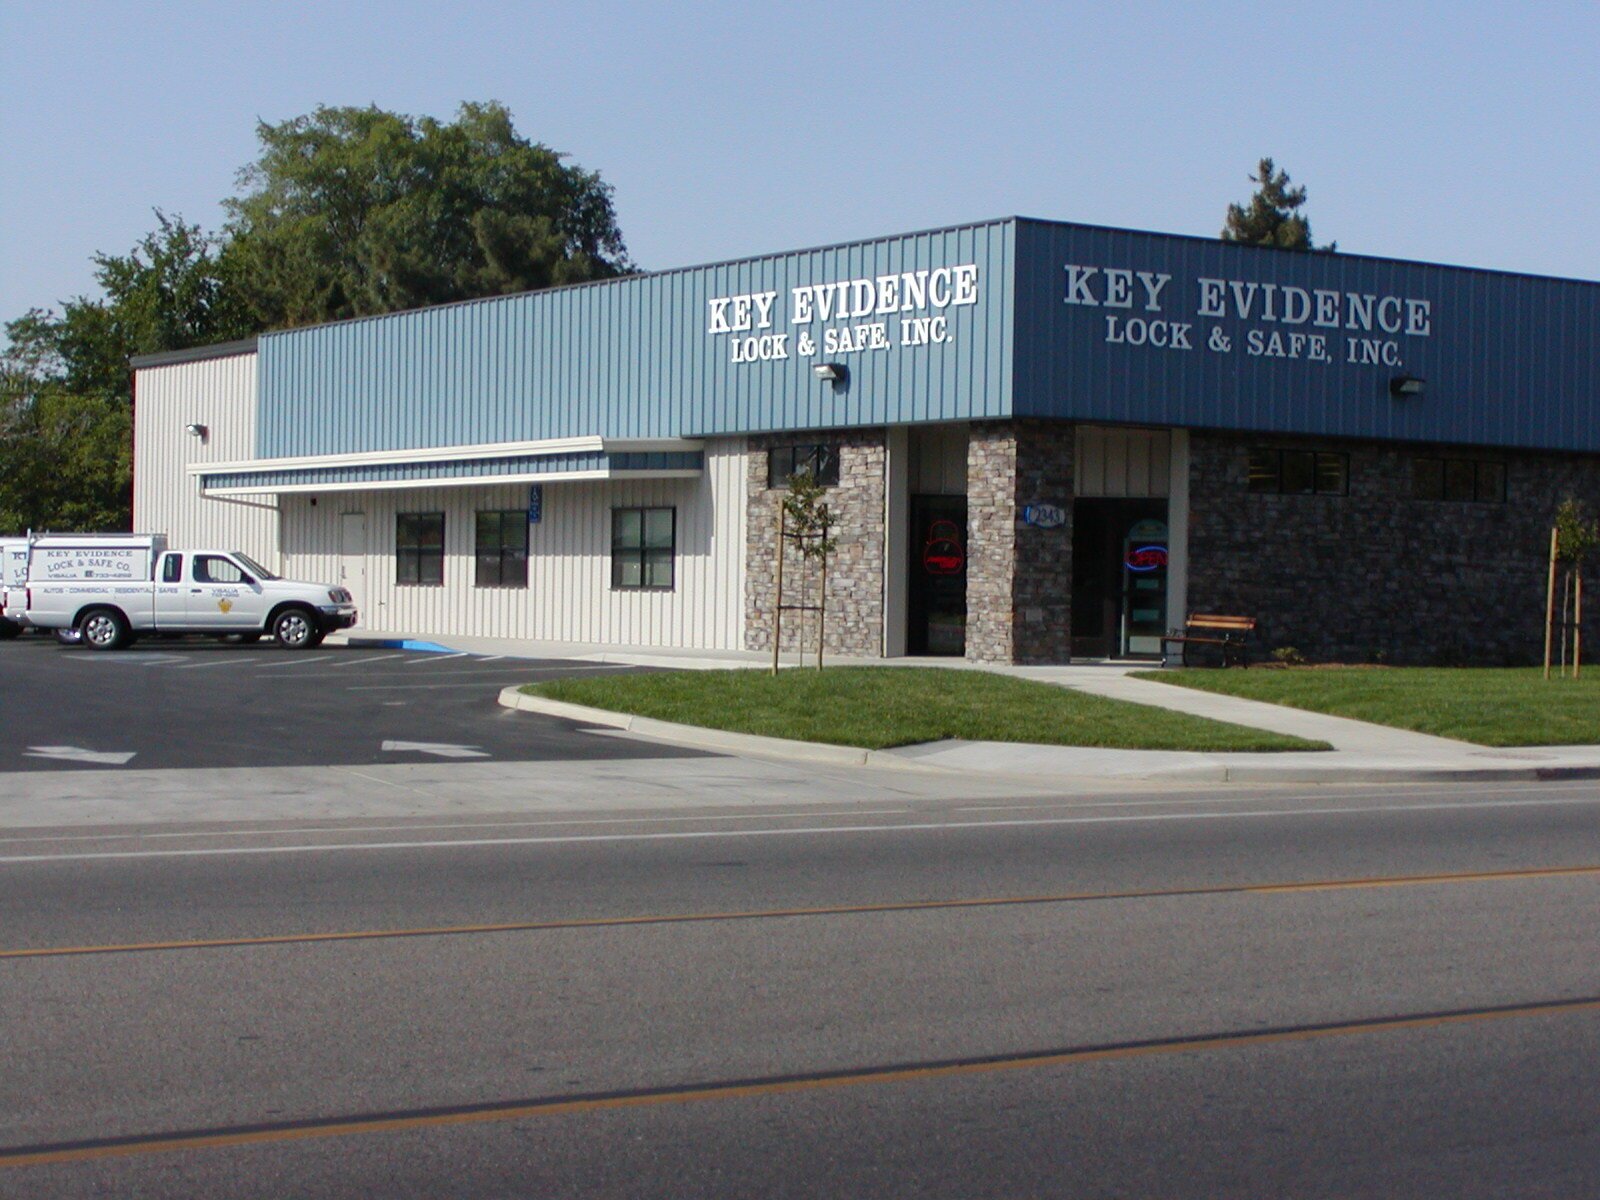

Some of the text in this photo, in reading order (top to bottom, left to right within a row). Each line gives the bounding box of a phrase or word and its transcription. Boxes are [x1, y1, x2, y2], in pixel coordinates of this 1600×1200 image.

[708, 264, 977, 334] KEY EVIDENCE
[1064, 264, 1431, 335] KEY EVIDENCE
[731, 316, 953, 363] LOCK & SAFE, INC.
[1105, 315, 1402, 366] LOCK & SAFE, INC.
[47, 560, 74, 572] LOCK
[88, 559, 113, 568] SAFE
